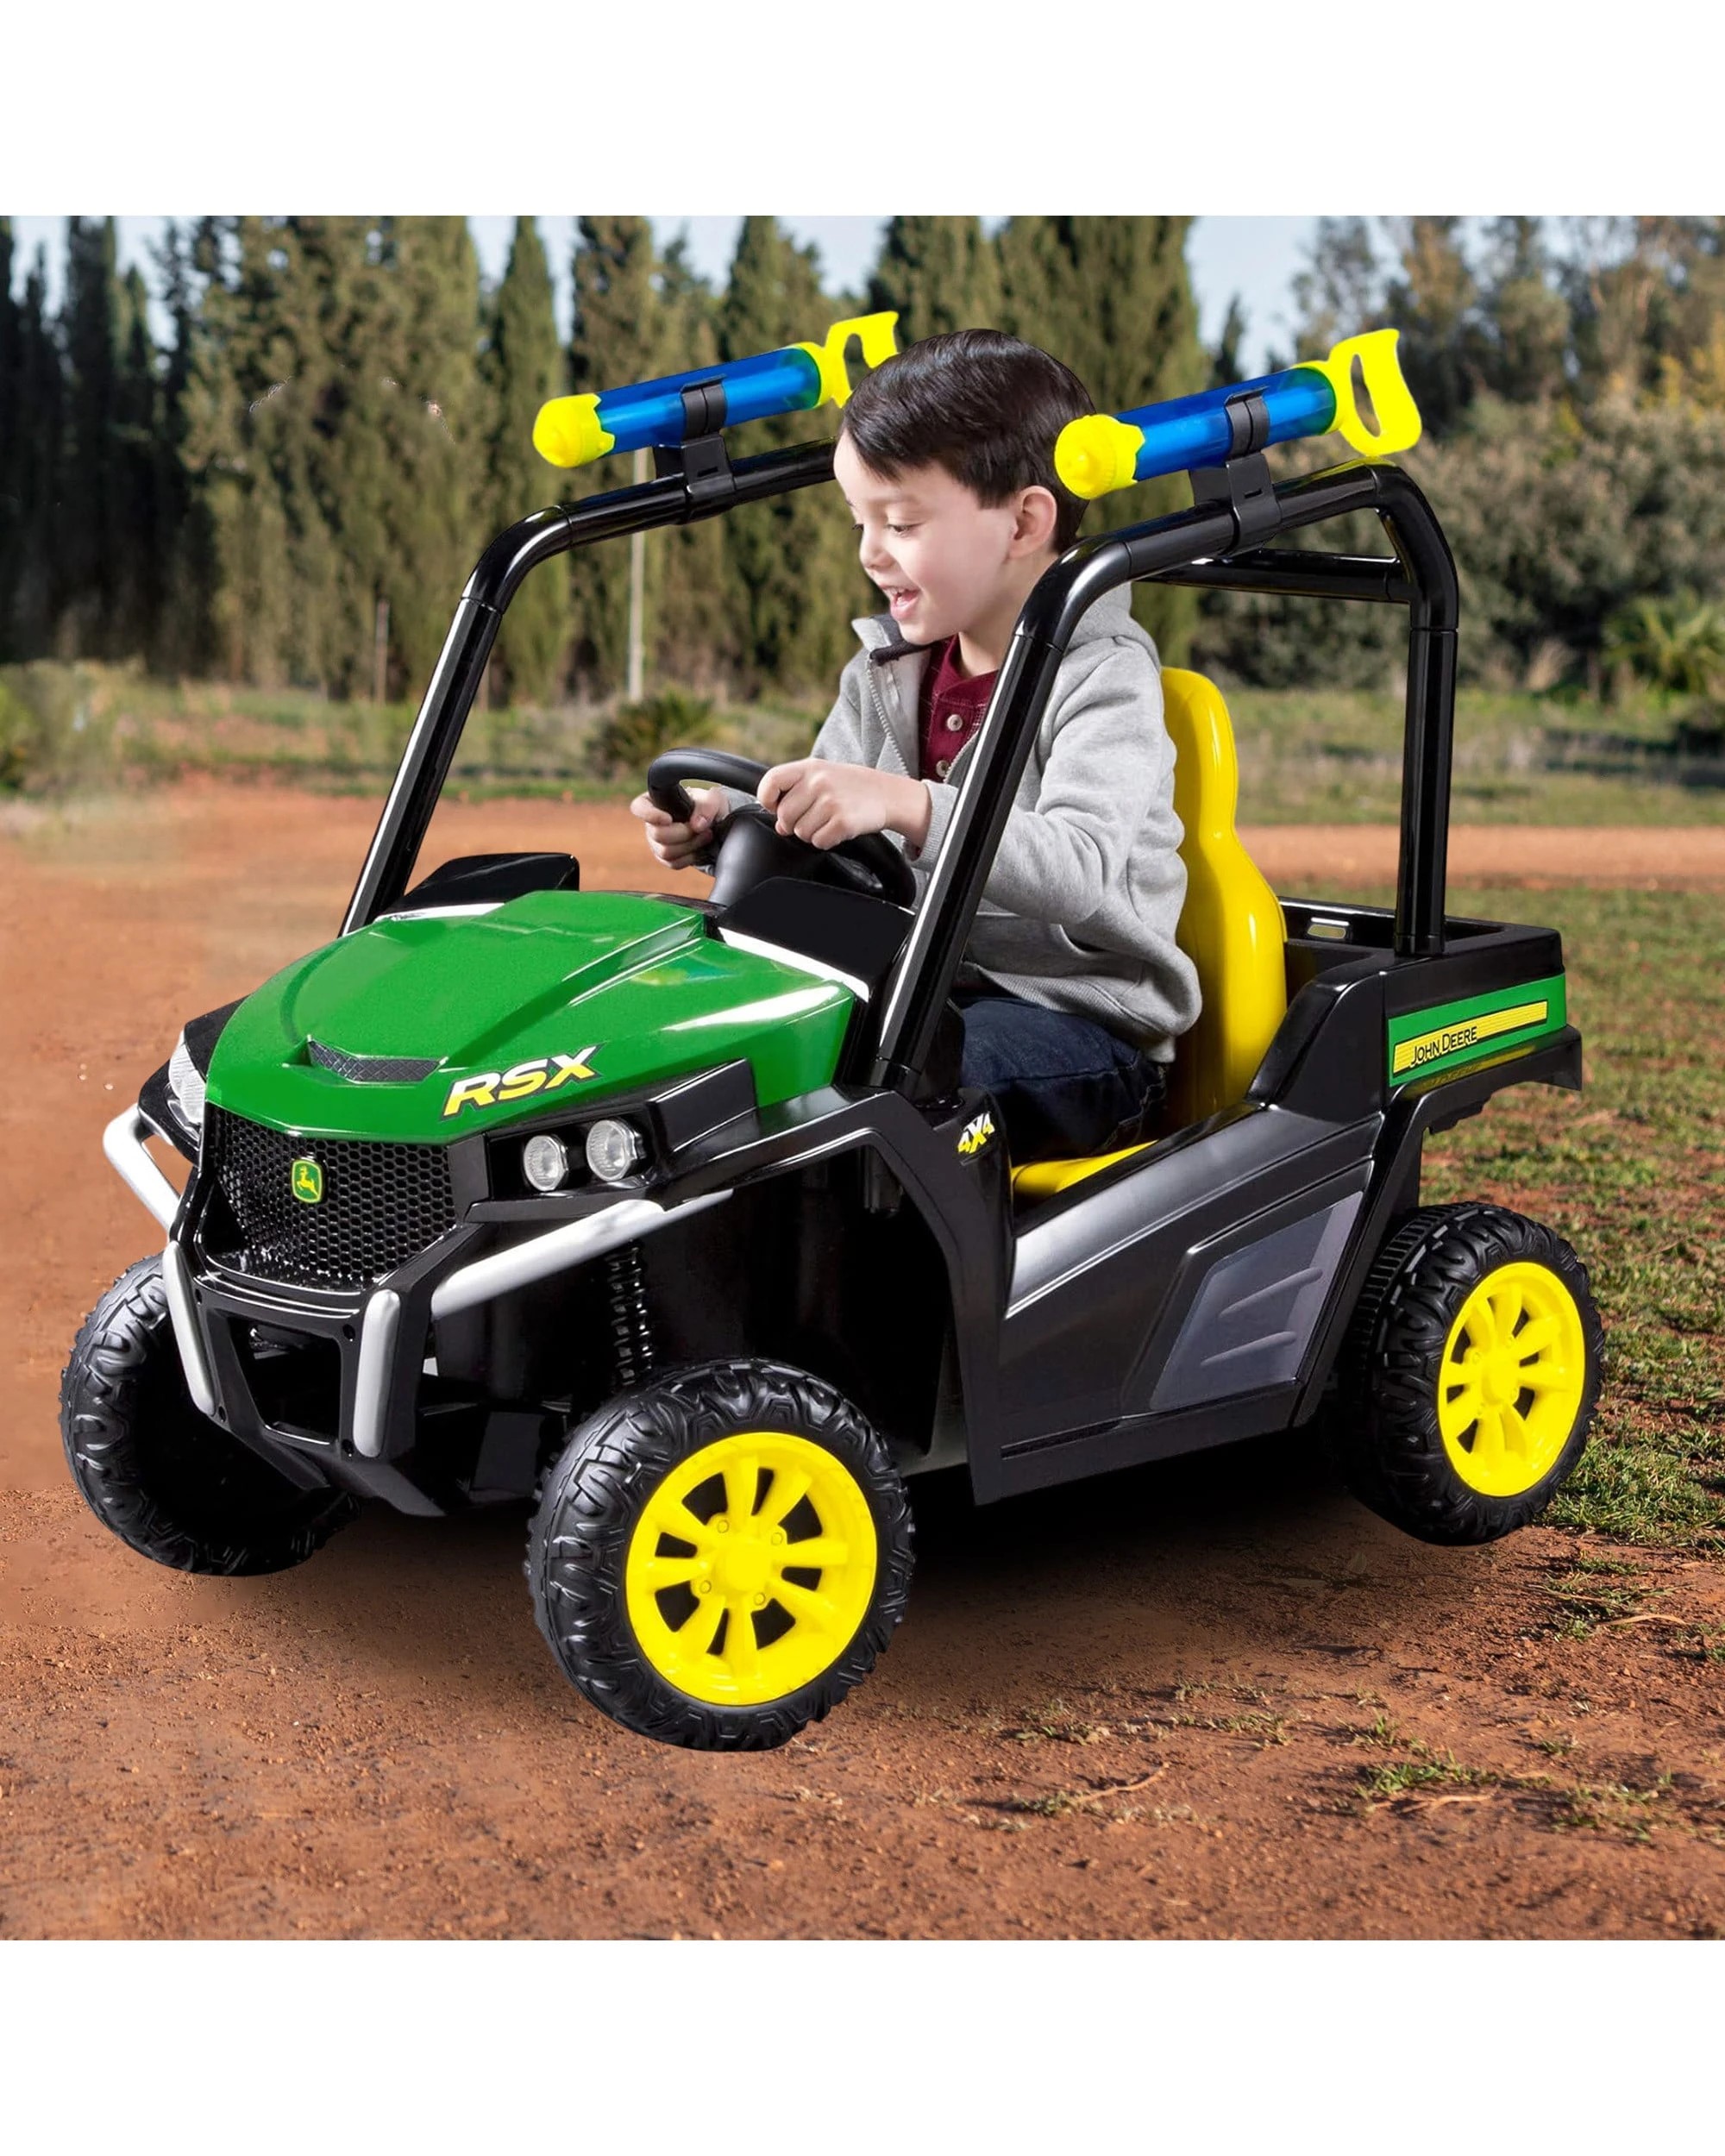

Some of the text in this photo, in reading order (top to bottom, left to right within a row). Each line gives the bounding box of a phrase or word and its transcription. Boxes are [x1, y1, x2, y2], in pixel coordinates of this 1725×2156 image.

[1410, 1025, 1477, 1065] JOHN DEERE
[442, 1044, 600, 1118] RSX
